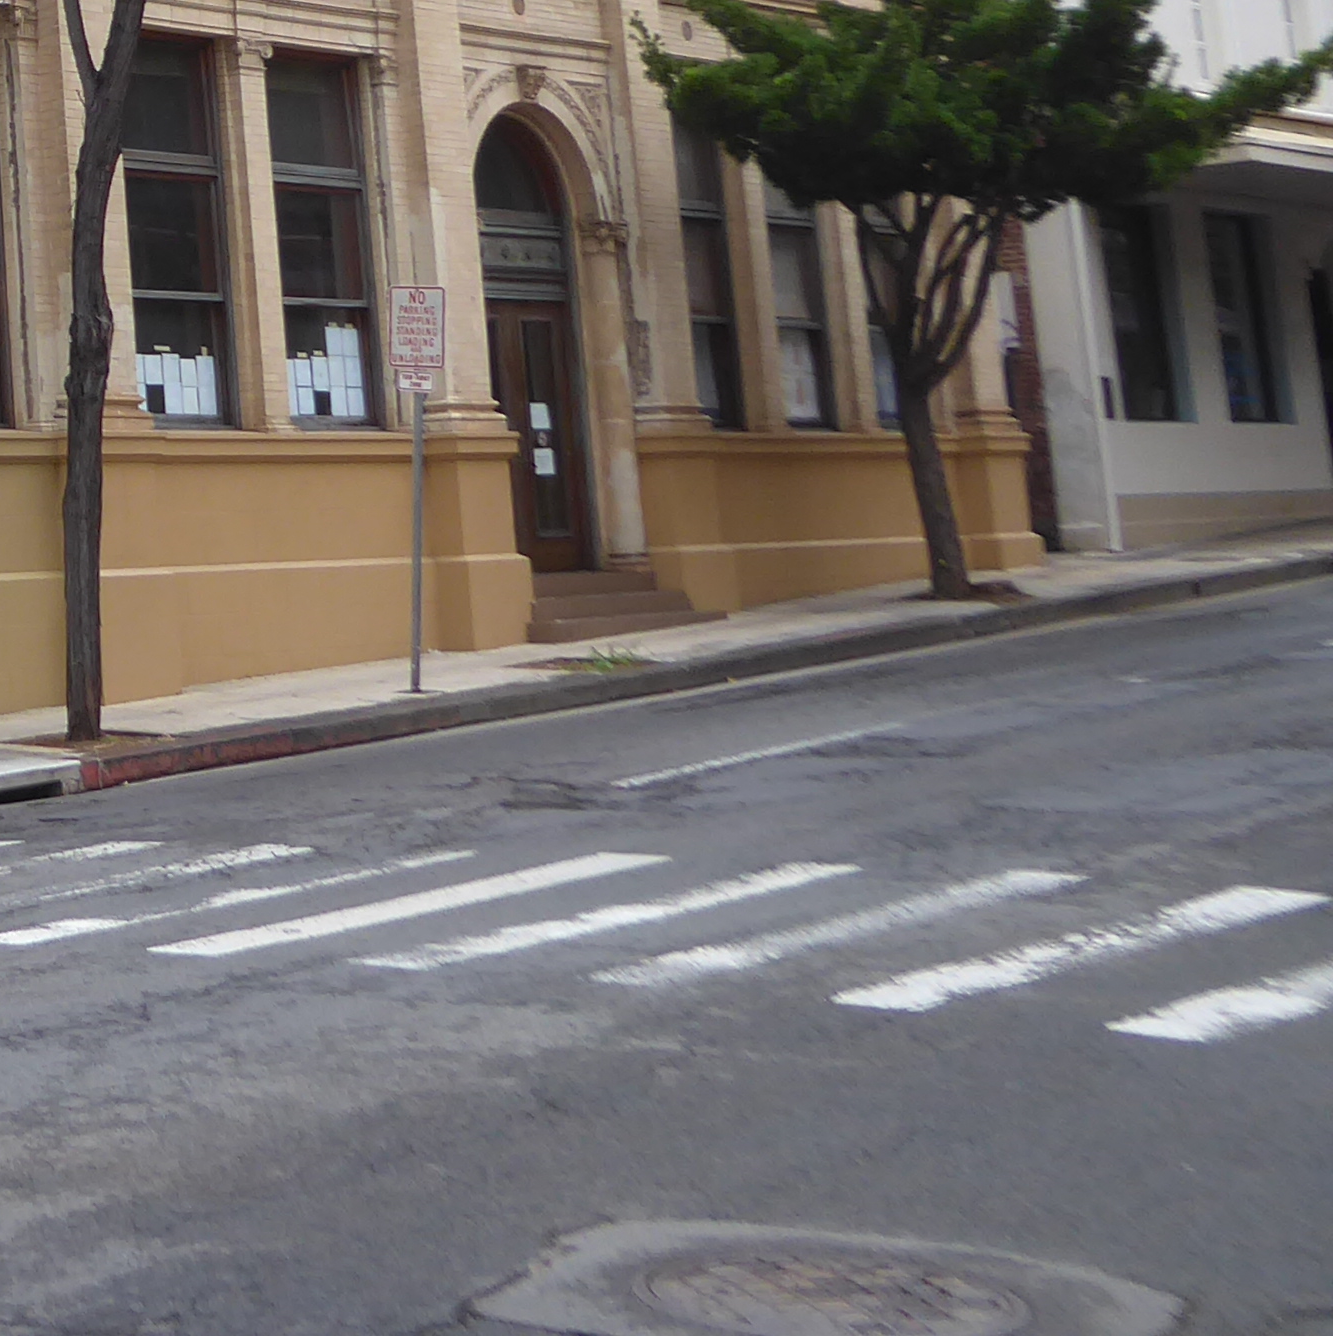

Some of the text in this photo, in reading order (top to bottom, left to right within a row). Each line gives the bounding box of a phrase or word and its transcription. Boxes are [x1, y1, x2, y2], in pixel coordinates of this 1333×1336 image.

[408, 290, 425, 305] NO
[399, 305, 435, 315] PARKING
[396, 326, 438, 337] STANDING
[398, 337, 435, 347] LOADING
[391, 353, 441, 364] UNLOADING
